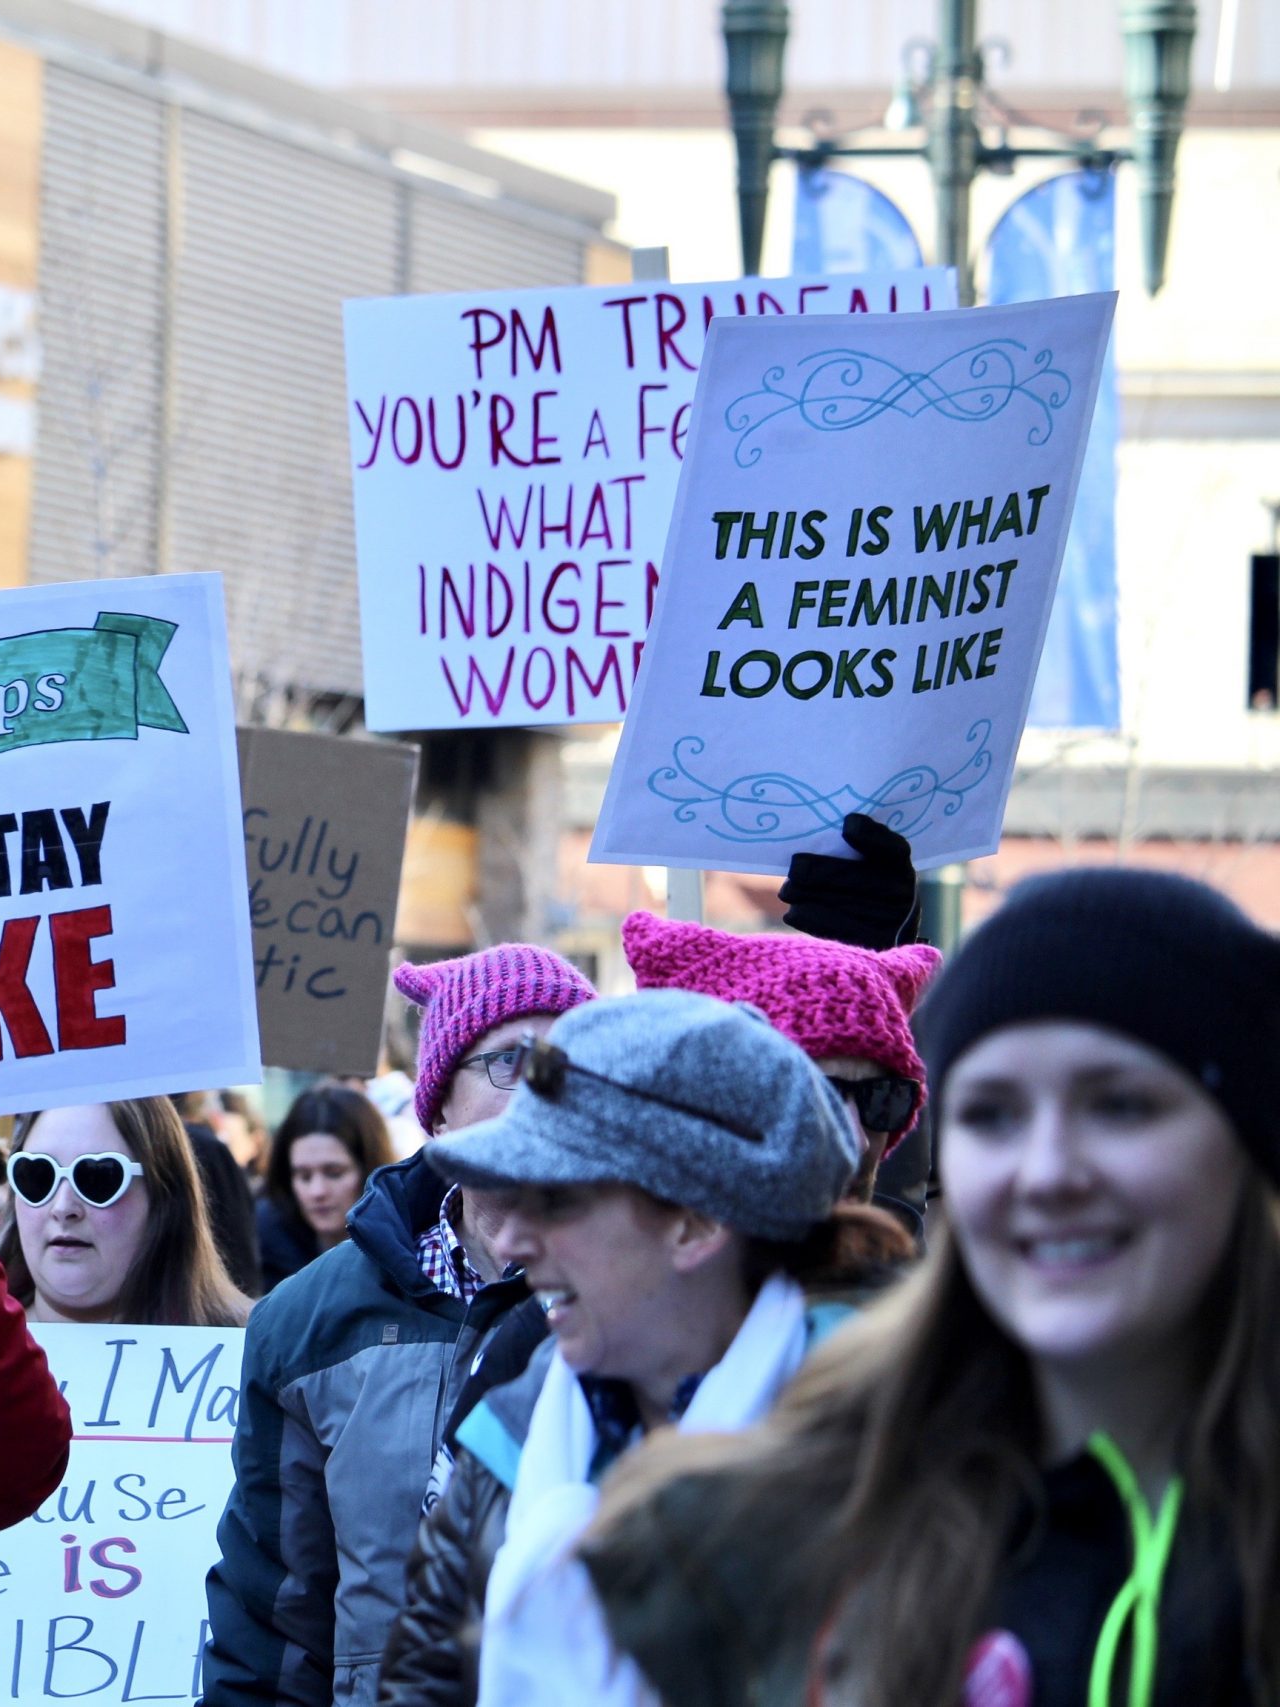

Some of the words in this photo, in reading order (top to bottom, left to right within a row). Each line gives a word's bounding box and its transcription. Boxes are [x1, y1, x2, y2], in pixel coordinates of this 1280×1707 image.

[460, 305, 562, 380] PM
[354, 389, 563, 470] YOU'RE
[583, 408, 611, 460] A
[476, 474, 646, 551] WHAT
[711, 509, 828, 560] THIS
[845, 506, 893, 557] IS
[913, 484, 1051, 553] WHAT
[716, 581, 764, 630] A
[787, 558, 1018, 629] FEMINIST
[699, 648, 897, 700] LOOKS
[912, 627, 1004, 694] LIKE
[285, 898, 383, 945] can
[83, 1338, 138, 1427] I
